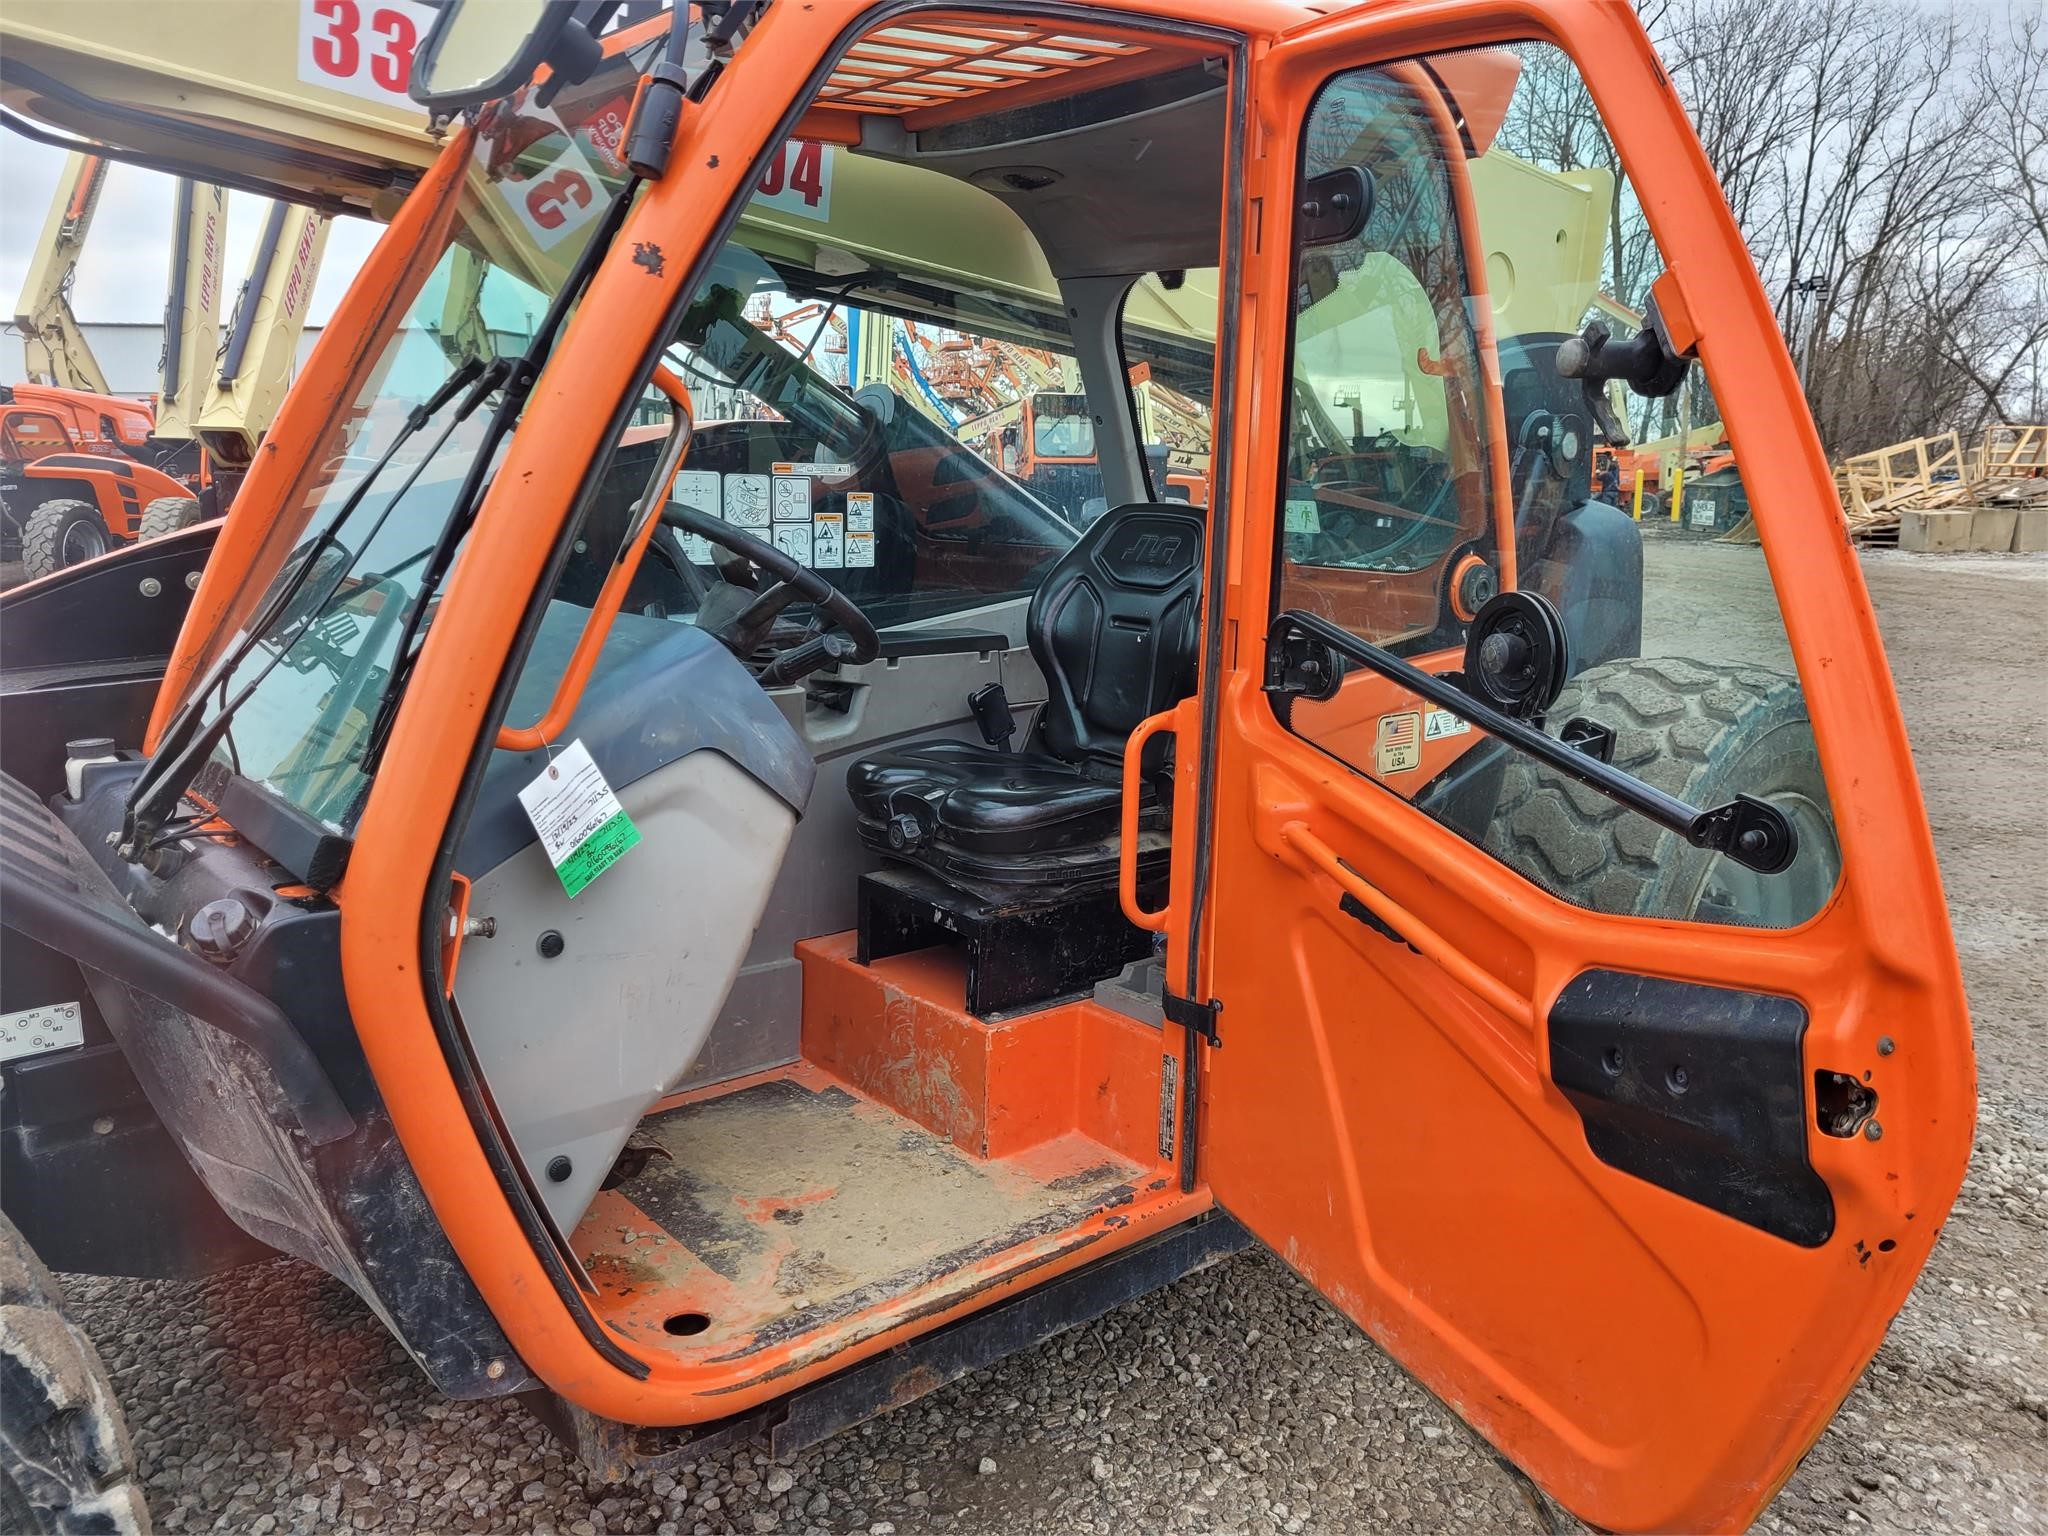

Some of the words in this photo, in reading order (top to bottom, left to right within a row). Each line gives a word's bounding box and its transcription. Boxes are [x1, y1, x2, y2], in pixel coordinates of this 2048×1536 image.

[204, 211, 216, 262] RENTS
[200, 263, 212, 313] LEPPO
[285, 264, 302, 319] LEPPO
[298, 216, 316, 269] RENTS
[971, 419, 988, 431] LEPPO
[1391, 757, 1405, 767] USA
